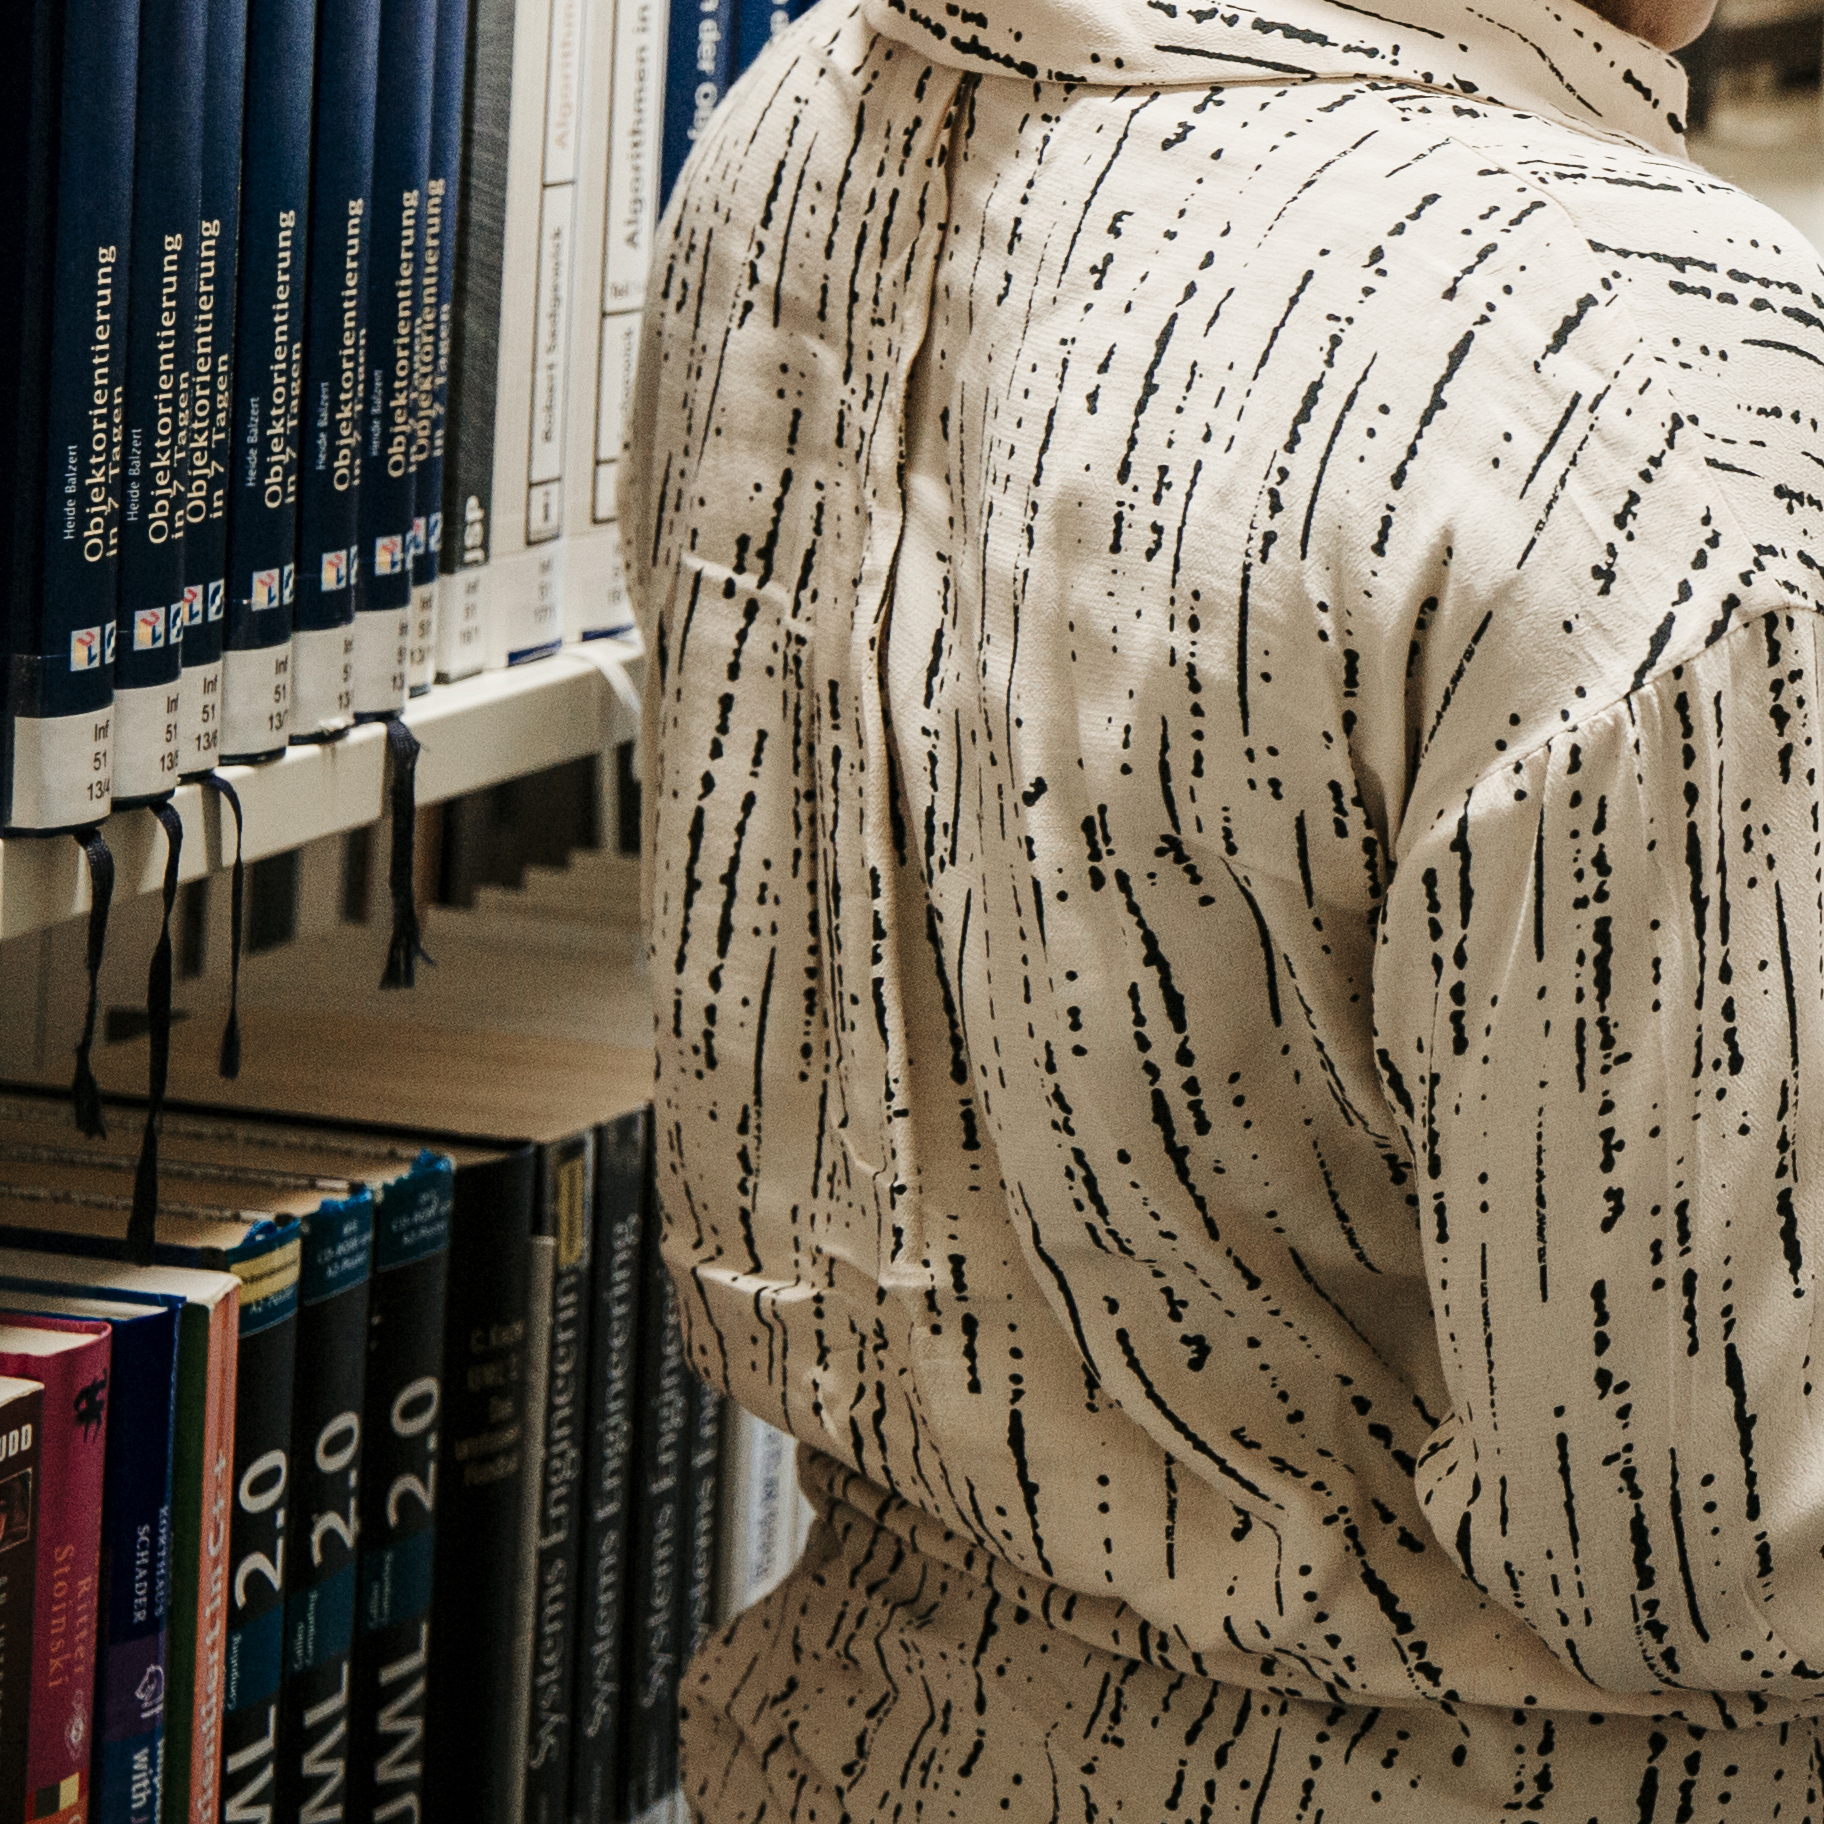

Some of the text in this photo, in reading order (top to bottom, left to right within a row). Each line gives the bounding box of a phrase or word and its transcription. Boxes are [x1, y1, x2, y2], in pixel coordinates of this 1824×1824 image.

[632, 4, 650, 33] in
[697, 18, 721, 71] der
[624, 43, 648, 249] Algorithmen
[186, 218, 220, 524] Objektorientierung
[264, 209, 296, 509] Objektorientierung
[334, 198, 364, 492] Objektorientierung
[388, 189, 419, 478] Objektorientierung
[84, 245, 117, 562] Objektorientierung
[148, 233, 183, 544] Objektorientierung
[207, 353, 229, 519] in 7 Tagen
[283, 342, 301, 504] in 7 Tagen
[63, 444, 78, 540] Heide Balzert
[127, 428, 142, 522] Heide Balzert
[169, 371, 190, 540] in 7 Tagen
[463, 495, 484, 564] JSP
[202, 704, 215, 723] 51
[203, 674, 218, 695] Inf
[274, 684, 286, 703] 51
[275, 655, 288, 676] Inf
[93, 750, 107, 771] 51
[94, 719, 110, 742] Inf
[165, 723, 178, 742] 51
[195, 730, 218, 751] 13/6
[87, 779, 110, 800] 13/4
[311, 1409, 362, 1567] 2.0
[386, 1375, 442, 1529] 2.0
[587, 1213, 639, 1737] Systems Engineering
[234, 1449, 288, 1610] 2.0
[529, 1274, 580, 1770] Systems Engineerin
[49, 1544, 74, 1687] Stoinski
[133, 1524, 151, 1624] SCHADER
[642, 1503, 676, 1707] Systems
[74, 1575, 92, 1674] Ritter
[227, 1632, 242, 1710] Computing
[131, 1745, 151, 1810] with
